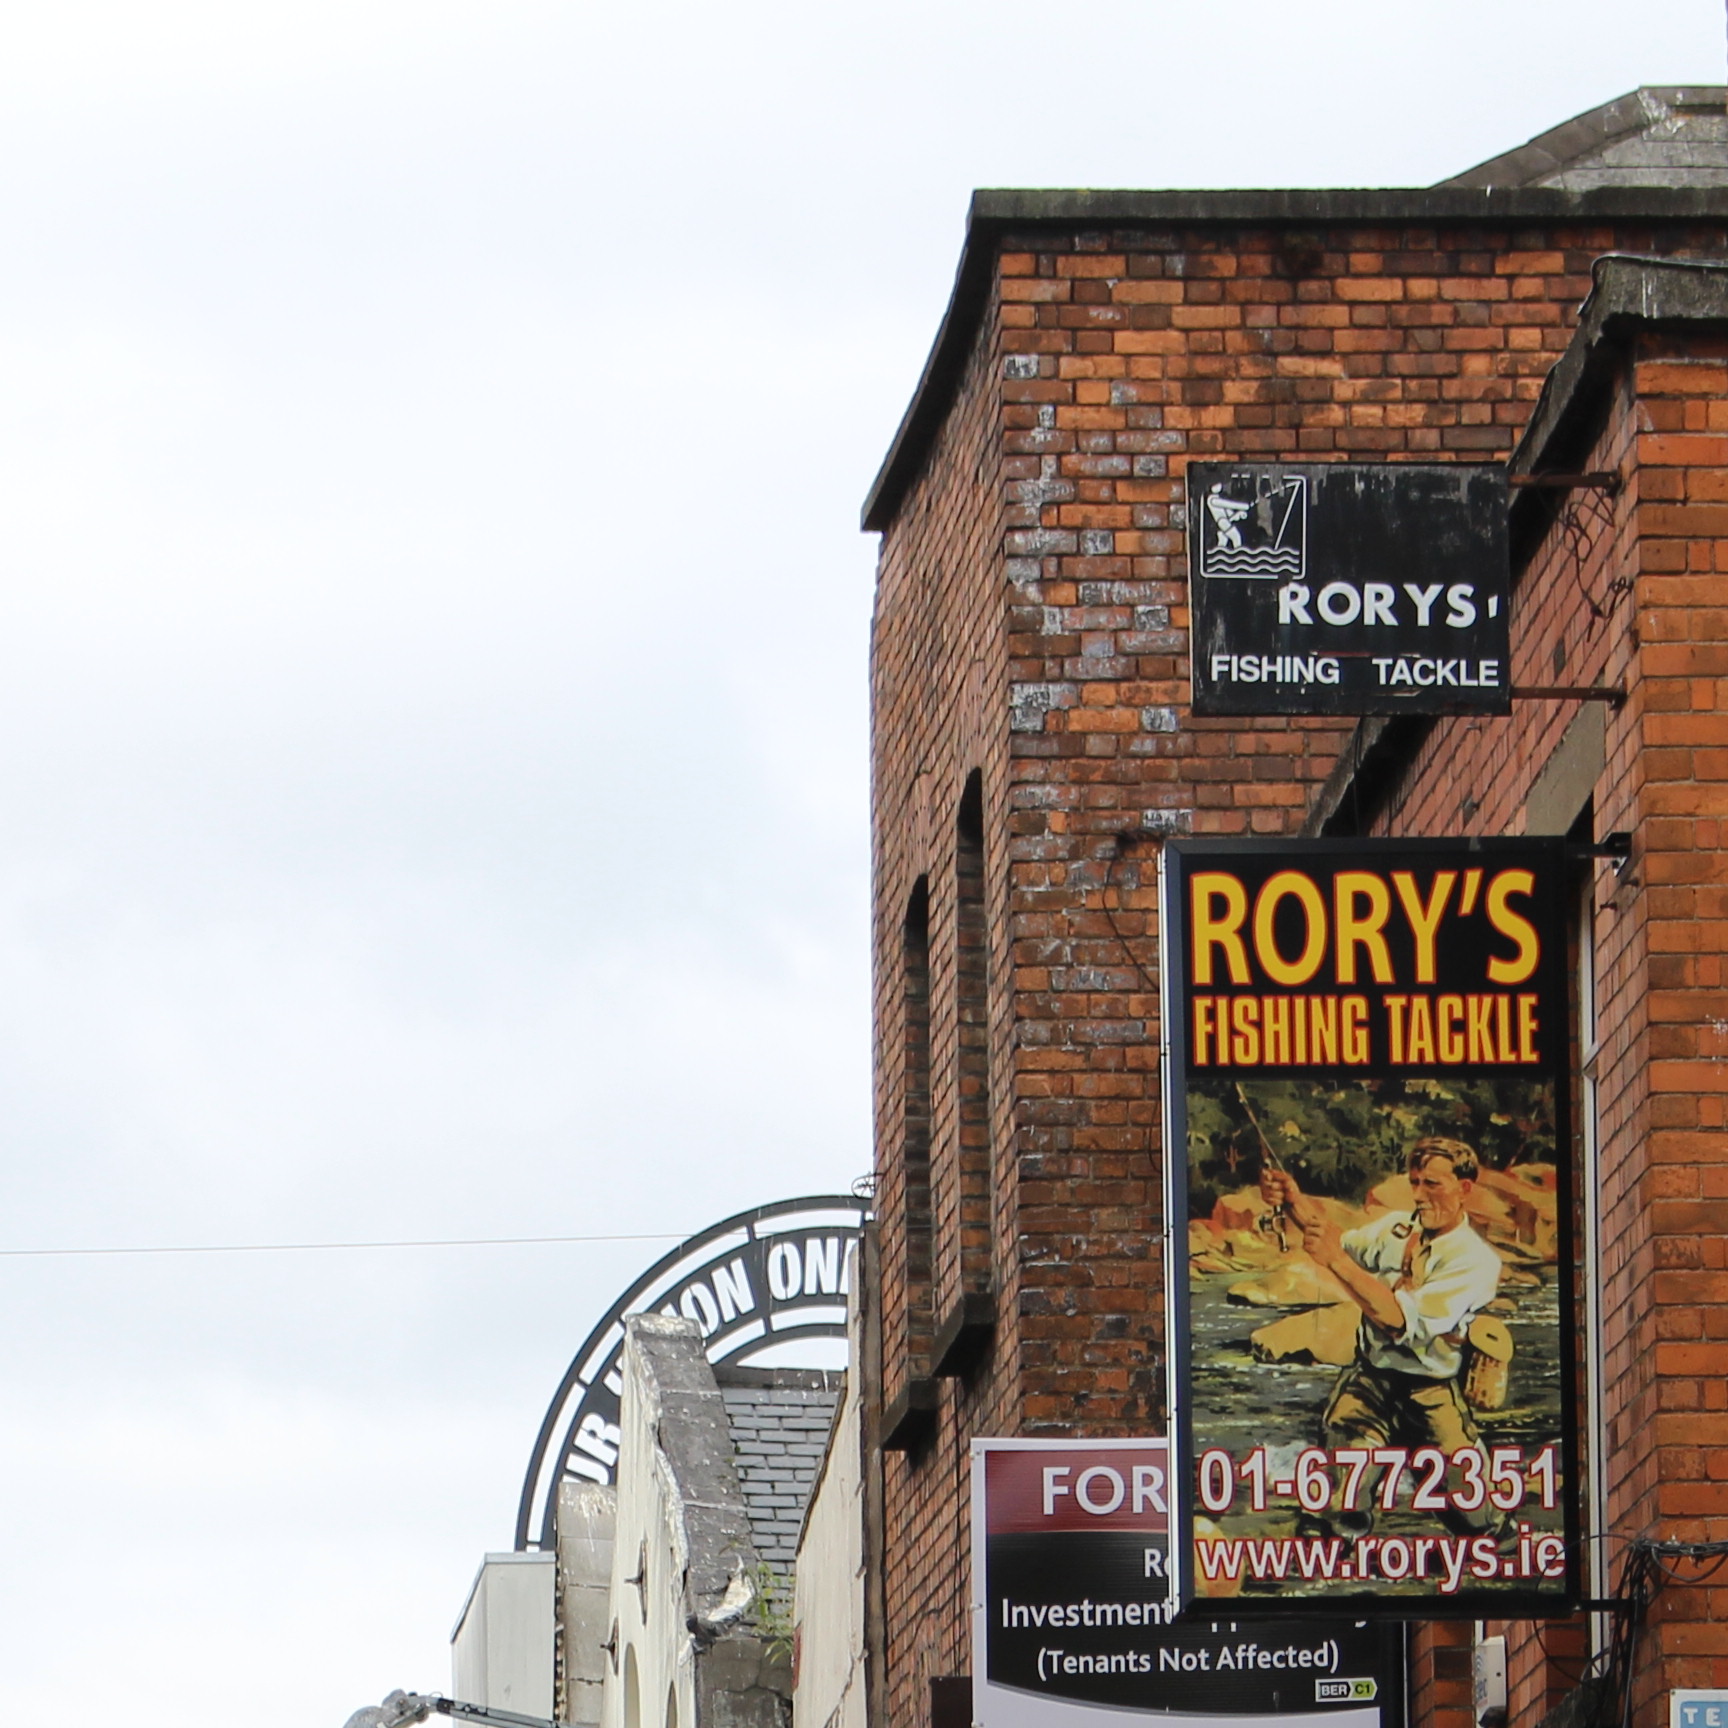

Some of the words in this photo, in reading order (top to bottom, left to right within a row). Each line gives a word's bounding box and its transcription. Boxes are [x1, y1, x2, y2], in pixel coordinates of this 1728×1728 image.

[1210, 654, 1340, 684] FISHING
[1372, 657, 1499, 687] TACKLE
[1189, 867, 1541, 985] RORY'S
[1192, 994, 1370, 1066] FISHING
[1383, 993, 1540, 1065] TACKLE
[1042, 1465, 1168, 1515] FOR
[1198, 1446, 1559, 1512] 01-6772351
[1194, 1523, 1566, 1594] www.rorys.ie
[1001, 1598, 1173, 1629] Investment
[1037, 1647, 1151, 1682] (Tenants
[1158, 1647, 1210, 1672] Not
[1215, 1639, 1340, 1674] Affected)
[1321, 1682, 1348, 1697] BER
[1354, 1681, 1371, 1696] C1
